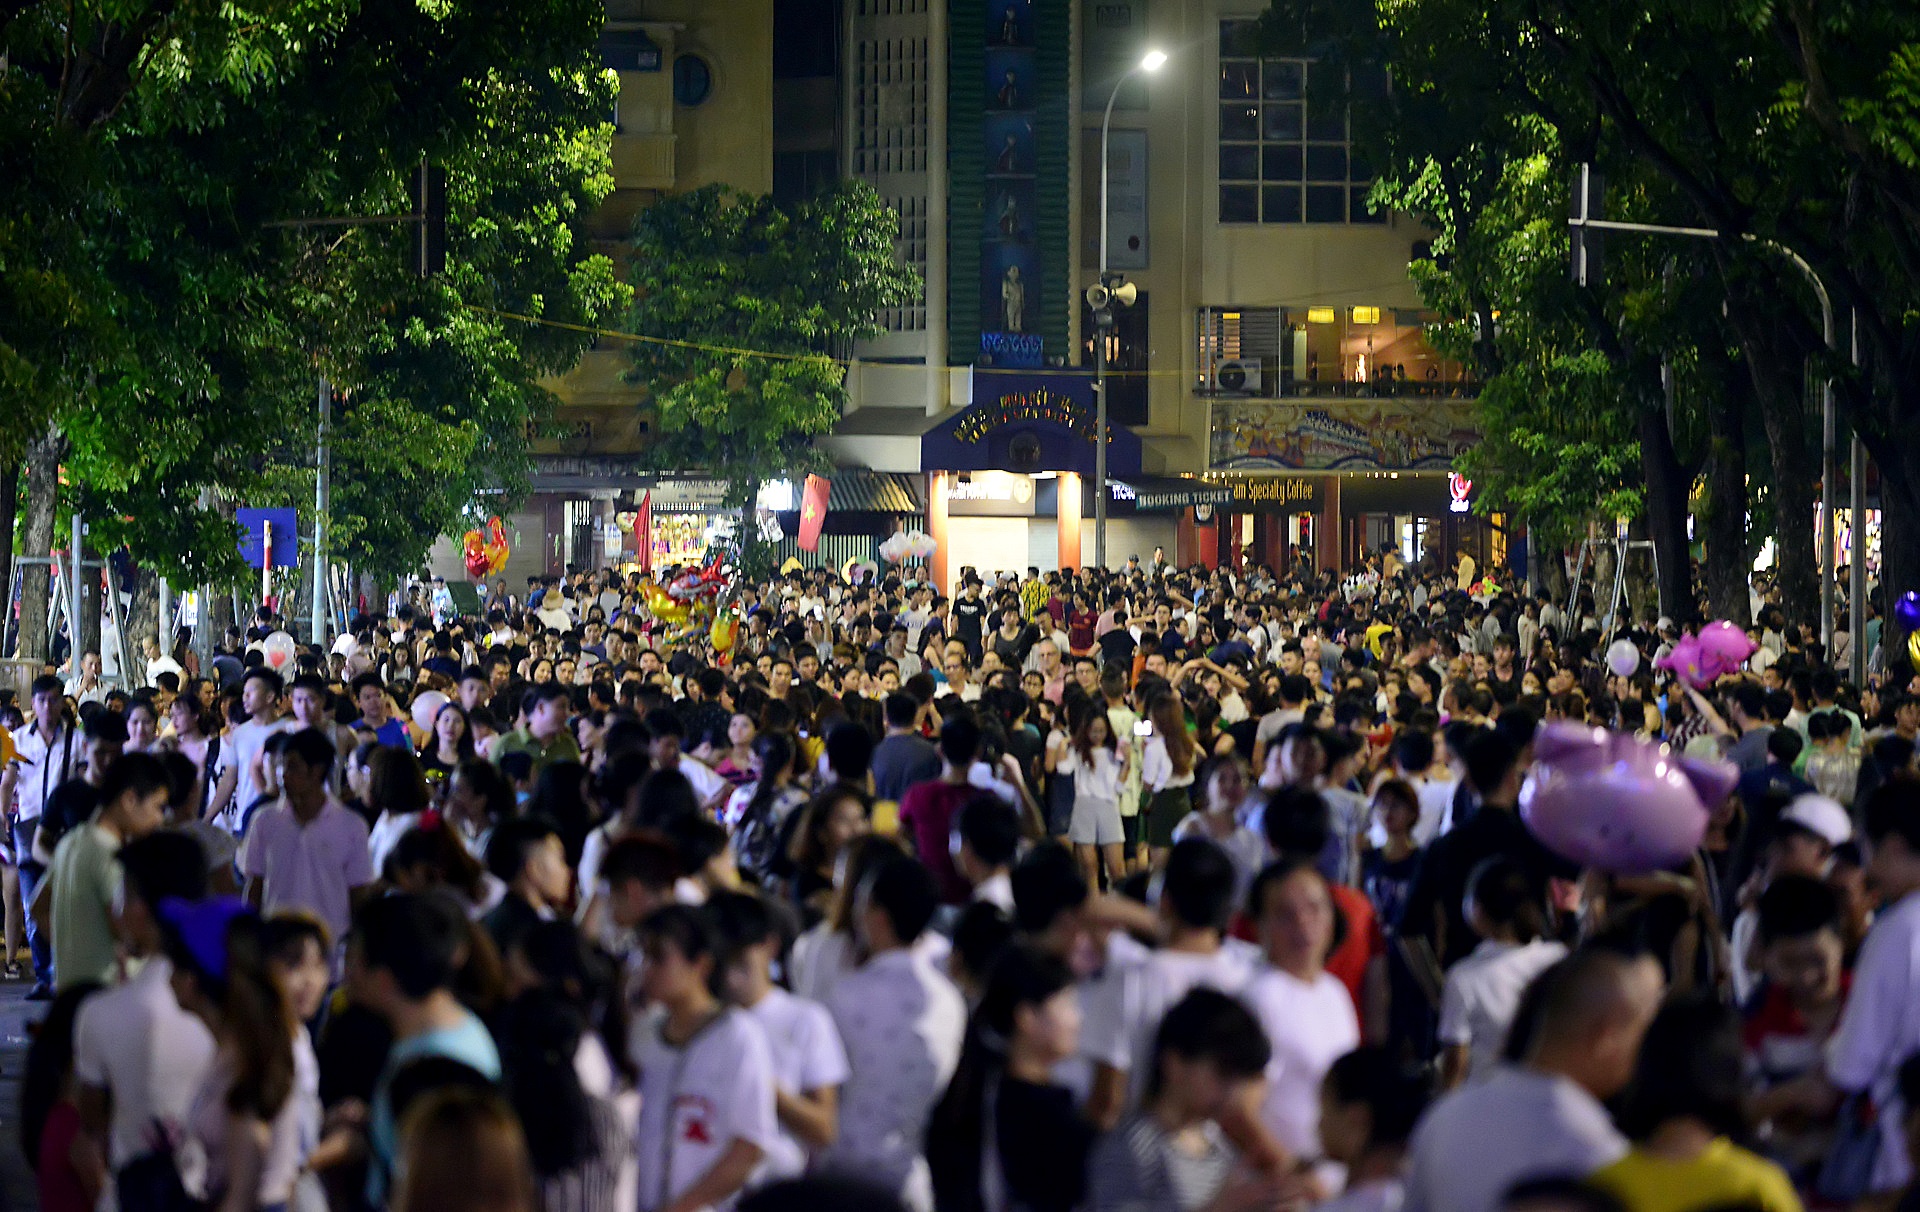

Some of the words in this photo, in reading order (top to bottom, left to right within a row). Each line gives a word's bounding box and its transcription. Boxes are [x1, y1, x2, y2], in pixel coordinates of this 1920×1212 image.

[1139, 491, 1190, 507] BOOKING
[1192, 489, 1231, 504] TICKET
[1248, 478, 1285, 506] Specialty
[1287, 478, 1313, 500] Coffee
